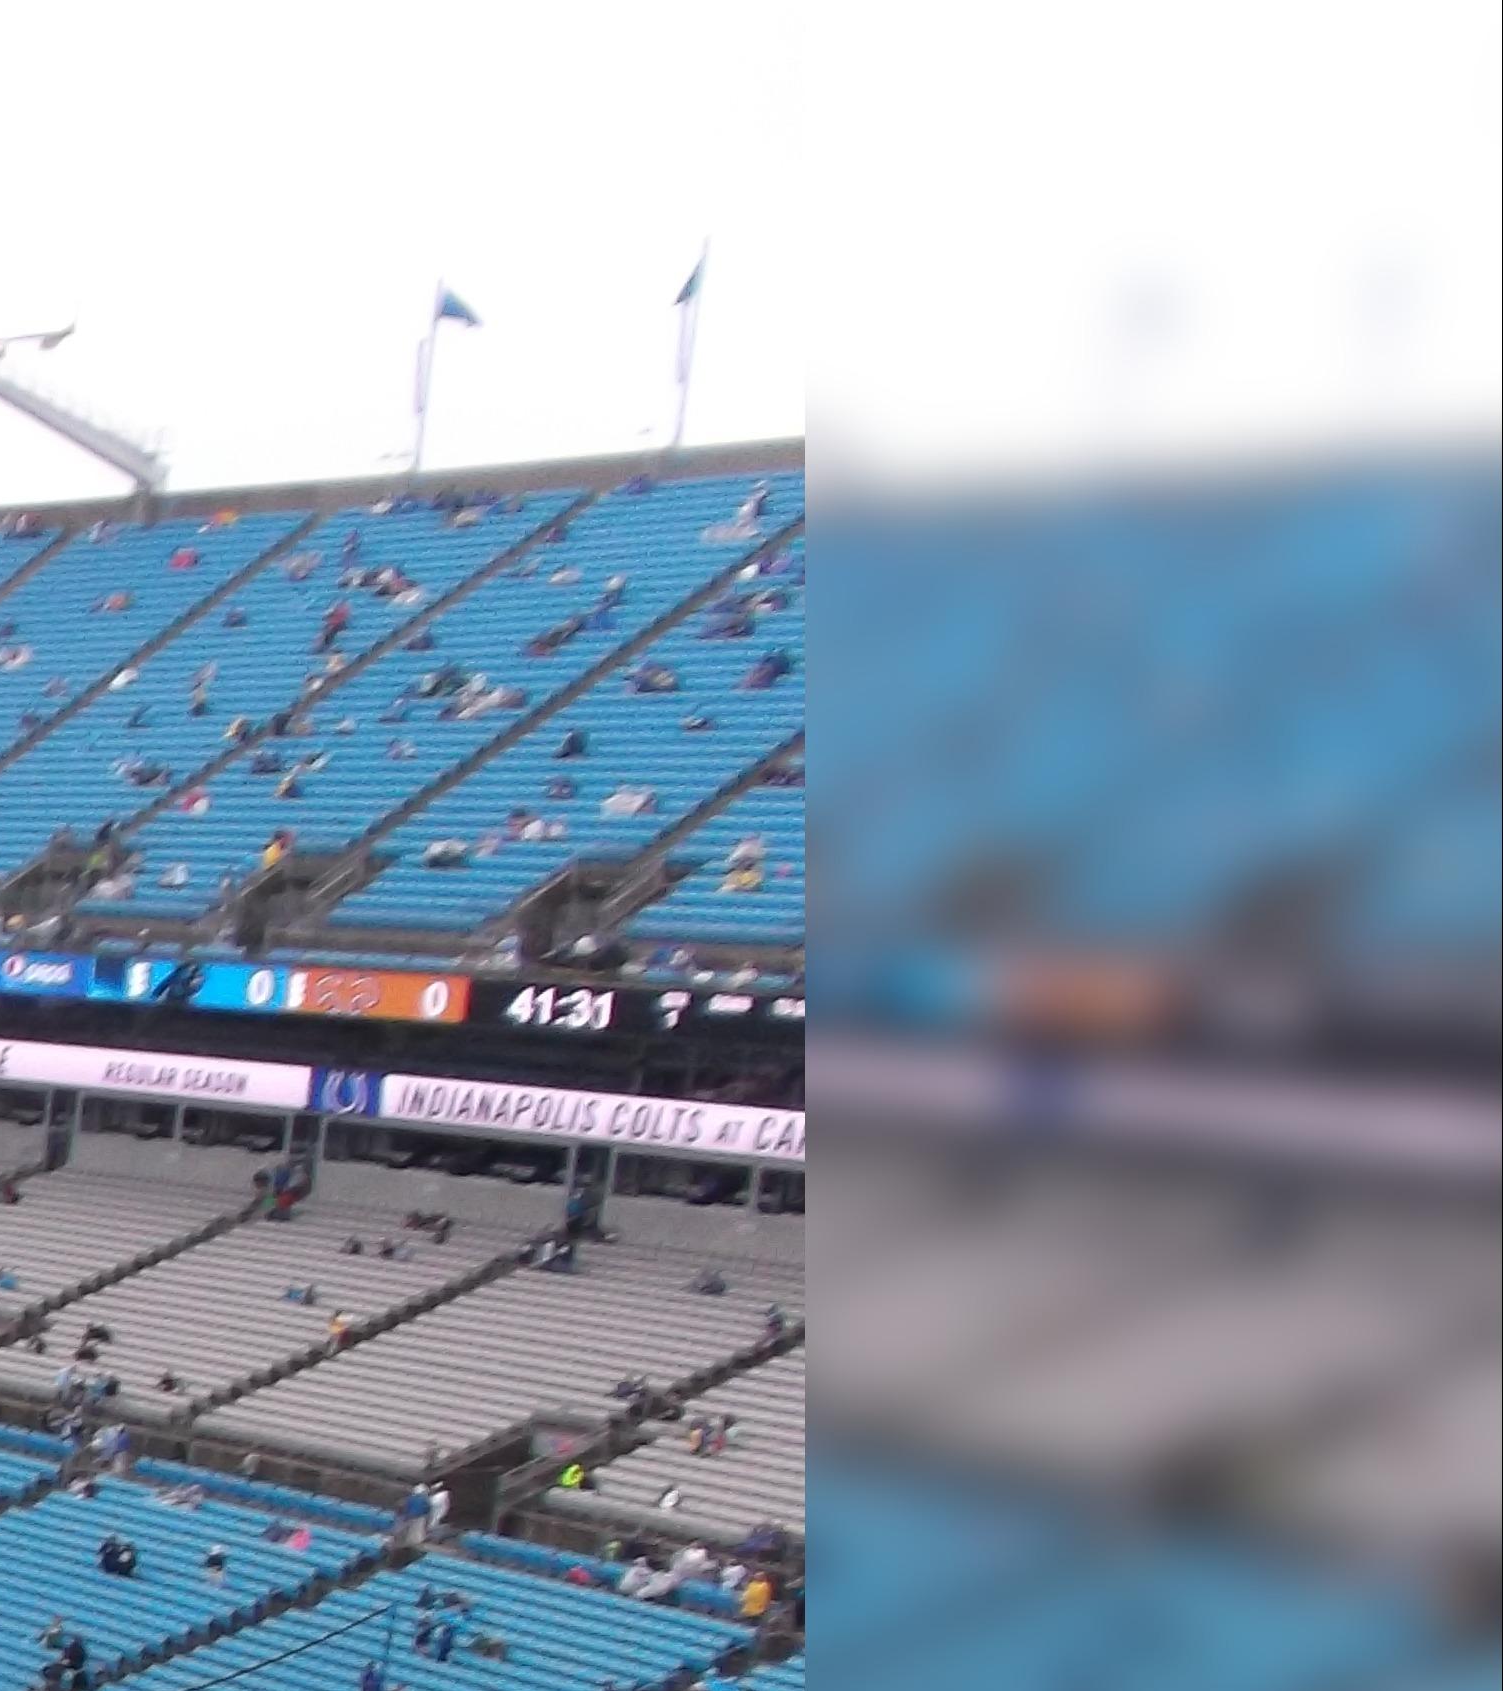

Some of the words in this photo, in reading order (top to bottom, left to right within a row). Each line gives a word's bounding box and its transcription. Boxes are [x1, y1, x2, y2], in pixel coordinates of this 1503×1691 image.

[246, 968, 275, 1006] 0
[420, 980, 449, 1018] 0
[506, 985, 616, 1031] 41:31
[104, 1061, 178, 1090] REGULAR
[182, 1068, 247, 1095] SEASON
[398, 1079, 596, 1133] INDIANAPOLIS
[611, 1102, 702, 1142] COLTS
[715, 1120, 744, 1143] AT
[754, 1116, 805, 1154] CA
